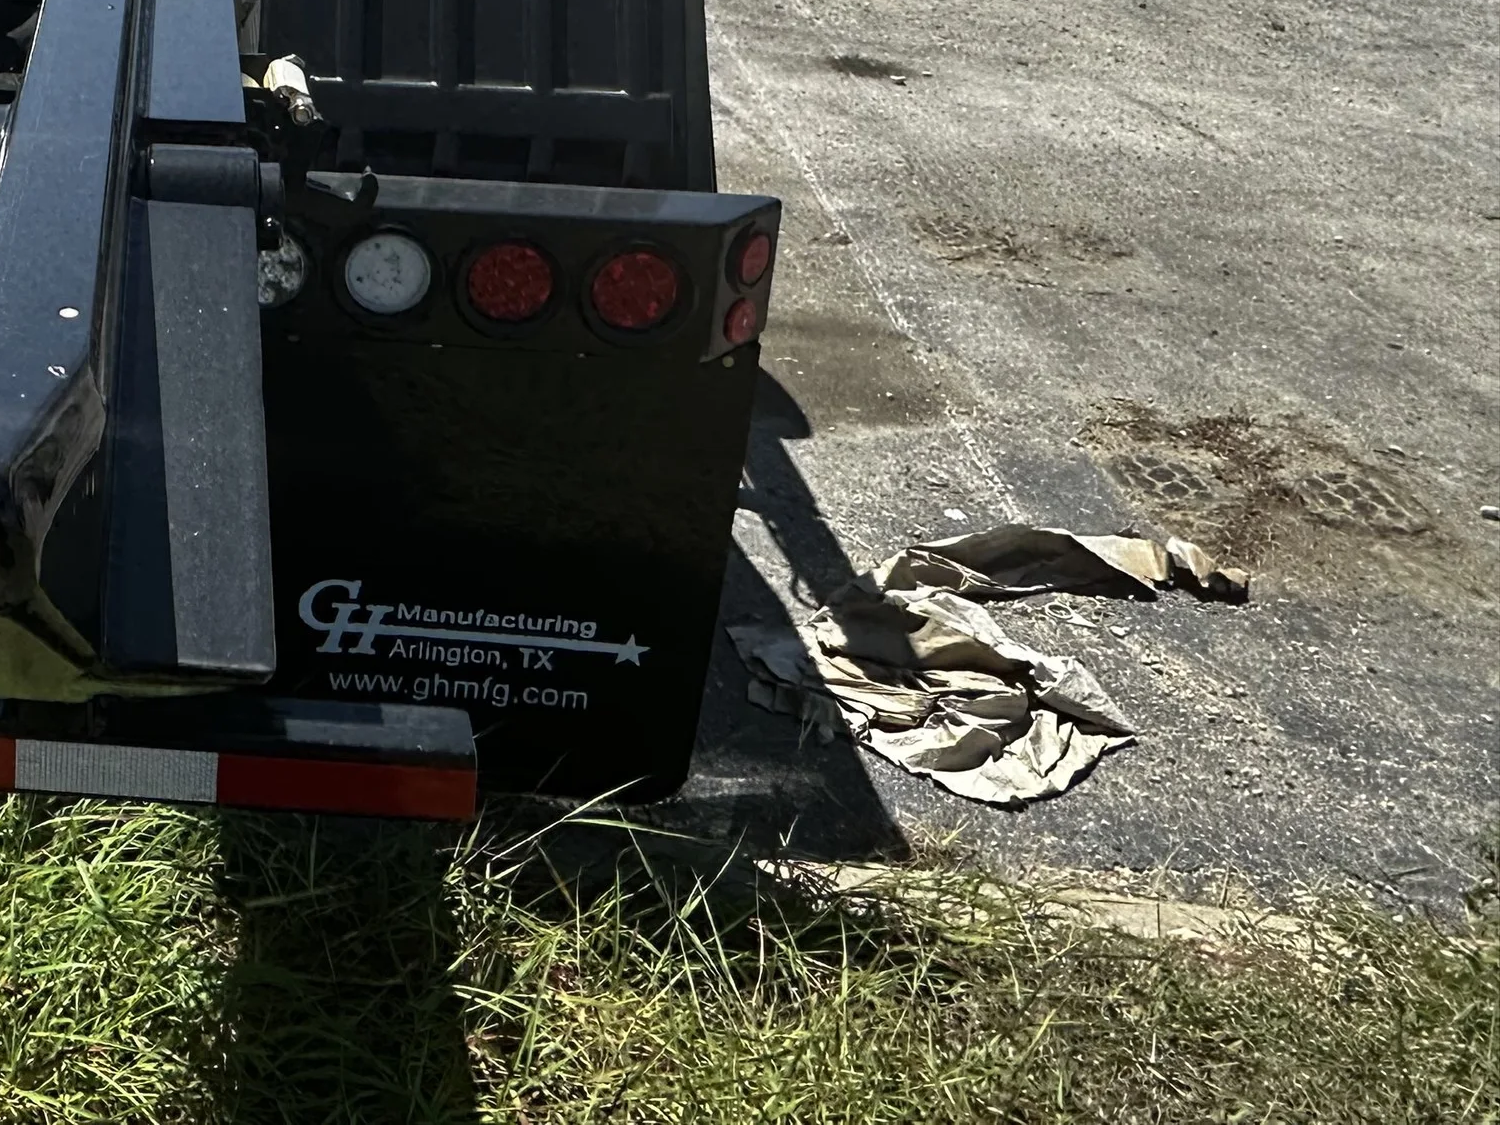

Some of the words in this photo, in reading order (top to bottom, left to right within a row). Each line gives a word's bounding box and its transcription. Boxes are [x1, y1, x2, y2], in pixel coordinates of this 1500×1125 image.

[397, 603, 597, 638] Manufacturing
[388, 639, 508, 670] Arlington,
[518, 647, 554, 671] TX
[330, 672, 588, 710] www.ghmfg.com
